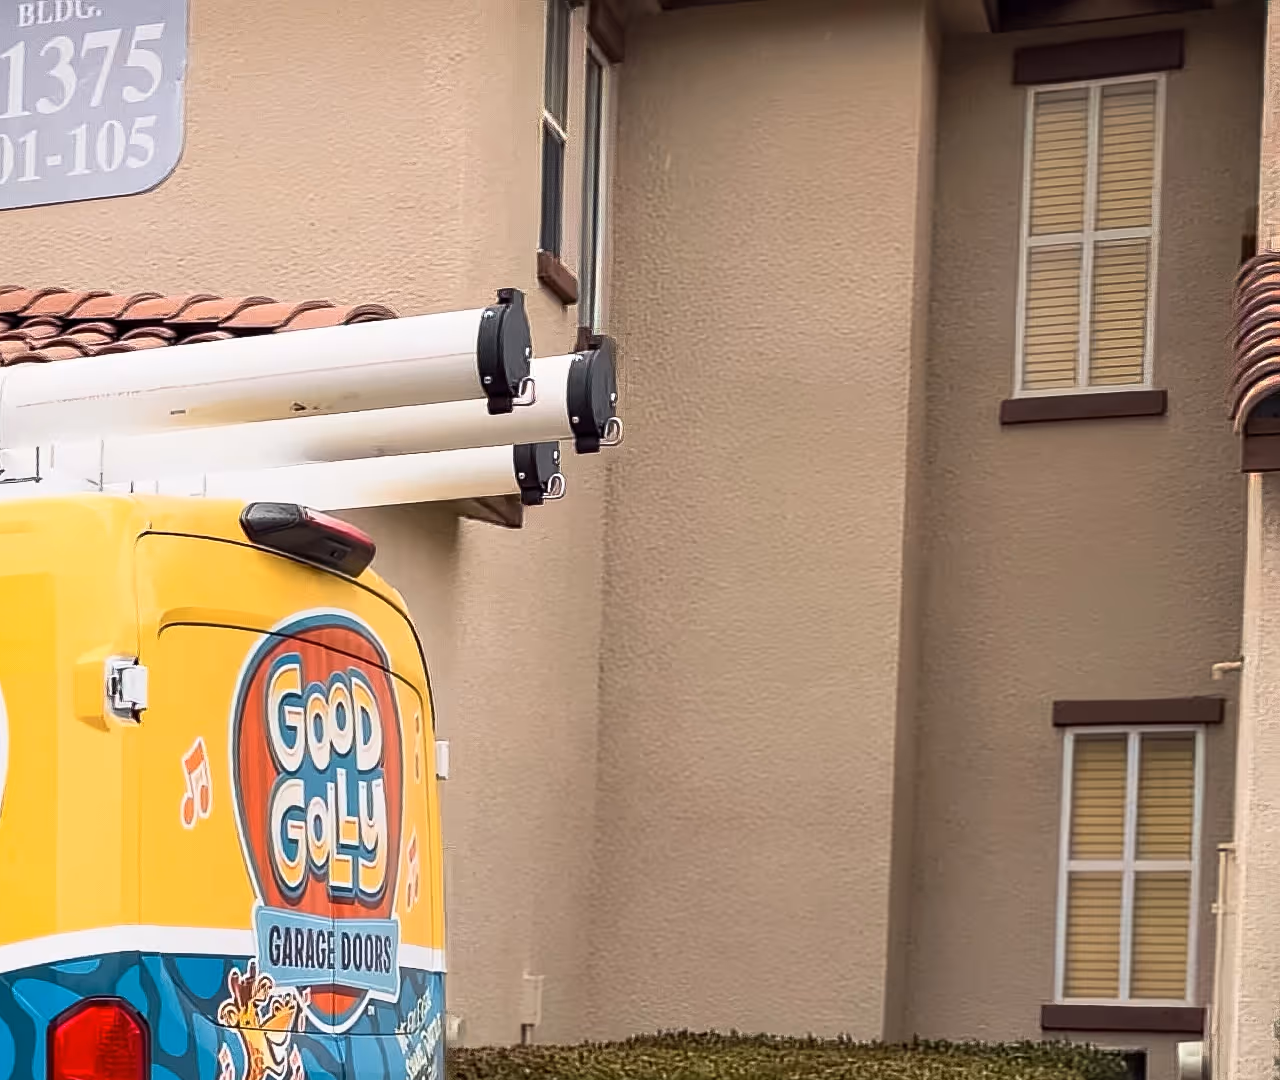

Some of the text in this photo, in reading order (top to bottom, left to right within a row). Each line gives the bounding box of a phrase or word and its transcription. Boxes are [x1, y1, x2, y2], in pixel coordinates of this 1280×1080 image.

[17, 0, 102, 27] BLDG.
[267, 663, 383, 772] GOOD
[269, 924, 392, 974] GARAGE DOORS
